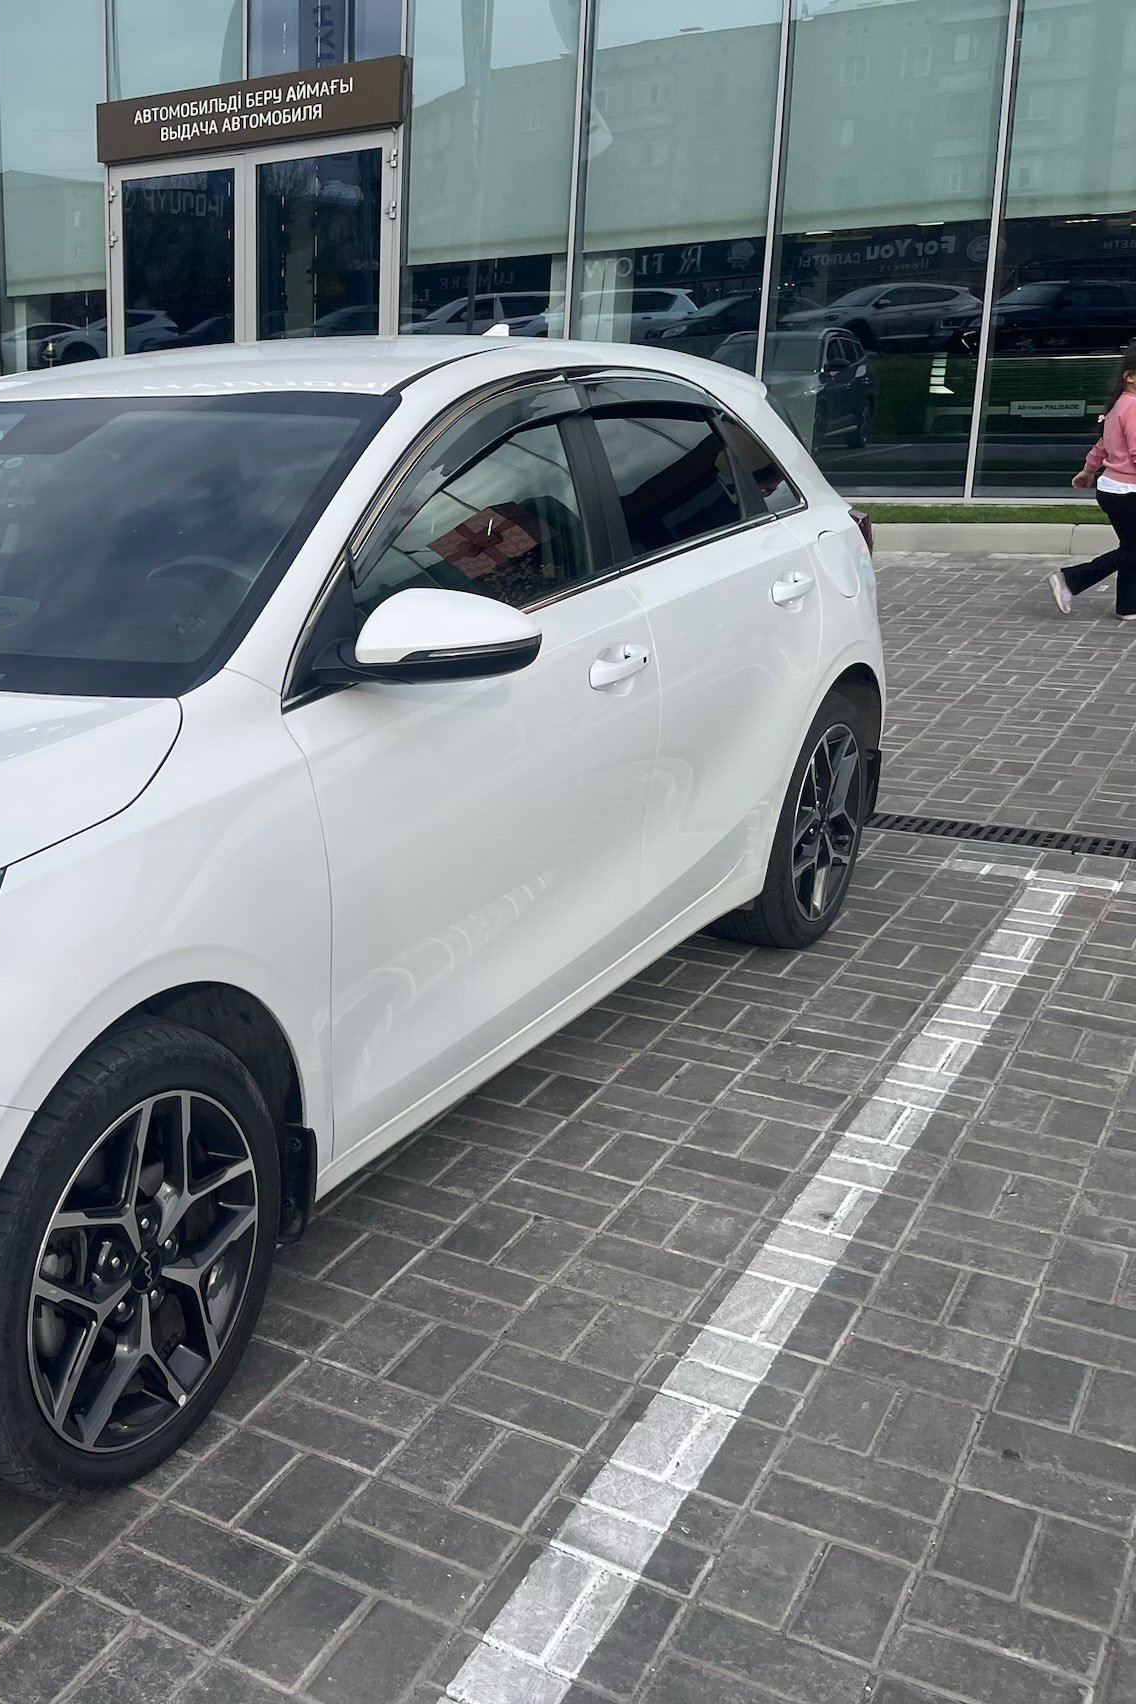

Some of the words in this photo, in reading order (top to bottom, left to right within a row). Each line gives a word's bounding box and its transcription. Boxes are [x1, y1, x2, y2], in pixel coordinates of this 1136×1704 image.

[133, 91, 242, 125] АВТОМОБИЛЬДІ
[245, 88, 283, 109] БЕРУ
[285, 76, 354, 103] АЙМАҒЫ
[160, 119, 219, 141] ВЫДАЧА
[221, 103, 323, 133] АВТОМОБИЛЯ
